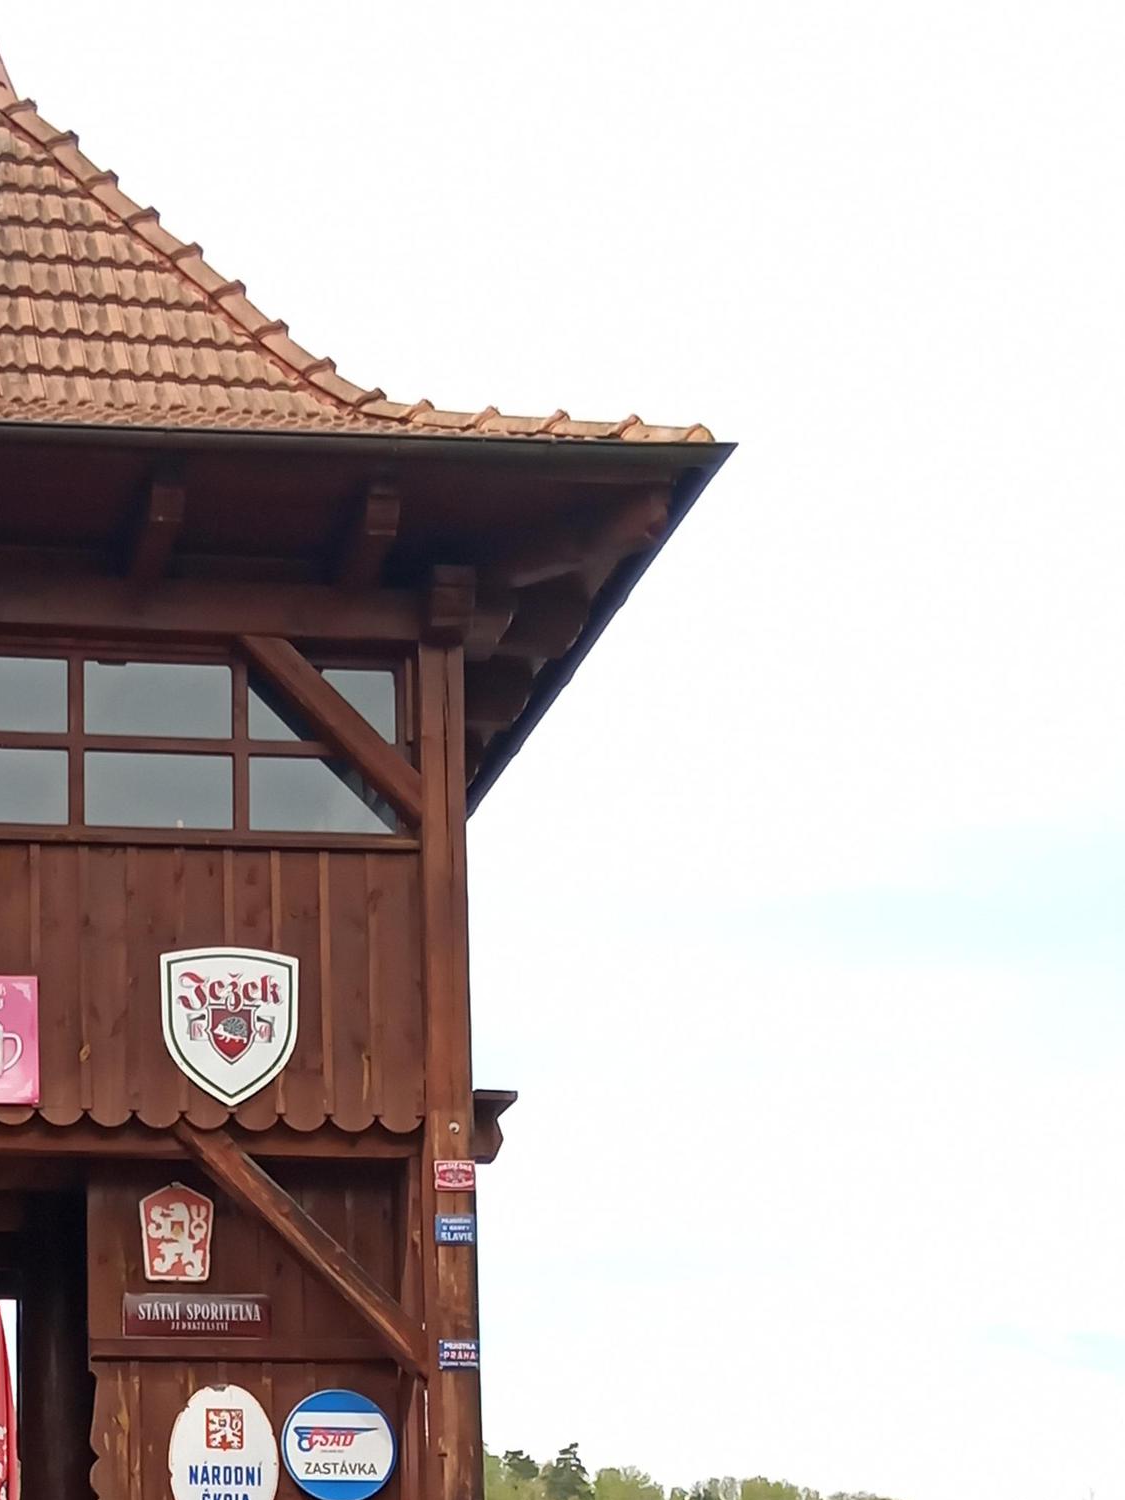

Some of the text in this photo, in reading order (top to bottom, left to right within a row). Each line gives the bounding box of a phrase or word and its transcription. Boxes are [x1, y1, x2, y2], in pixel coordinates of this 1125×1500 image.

[178, 972, 280, 1013] Ježek
[138, 1301, 261, 1322] STÁTNÍ SPOŘITELNA
[443, 1350, 476, 1360] PRAHA
[189, 1461, 262, 1487] NÁRODNÍ
[304, 1460, 378, 1475] ZASTÁVKA
